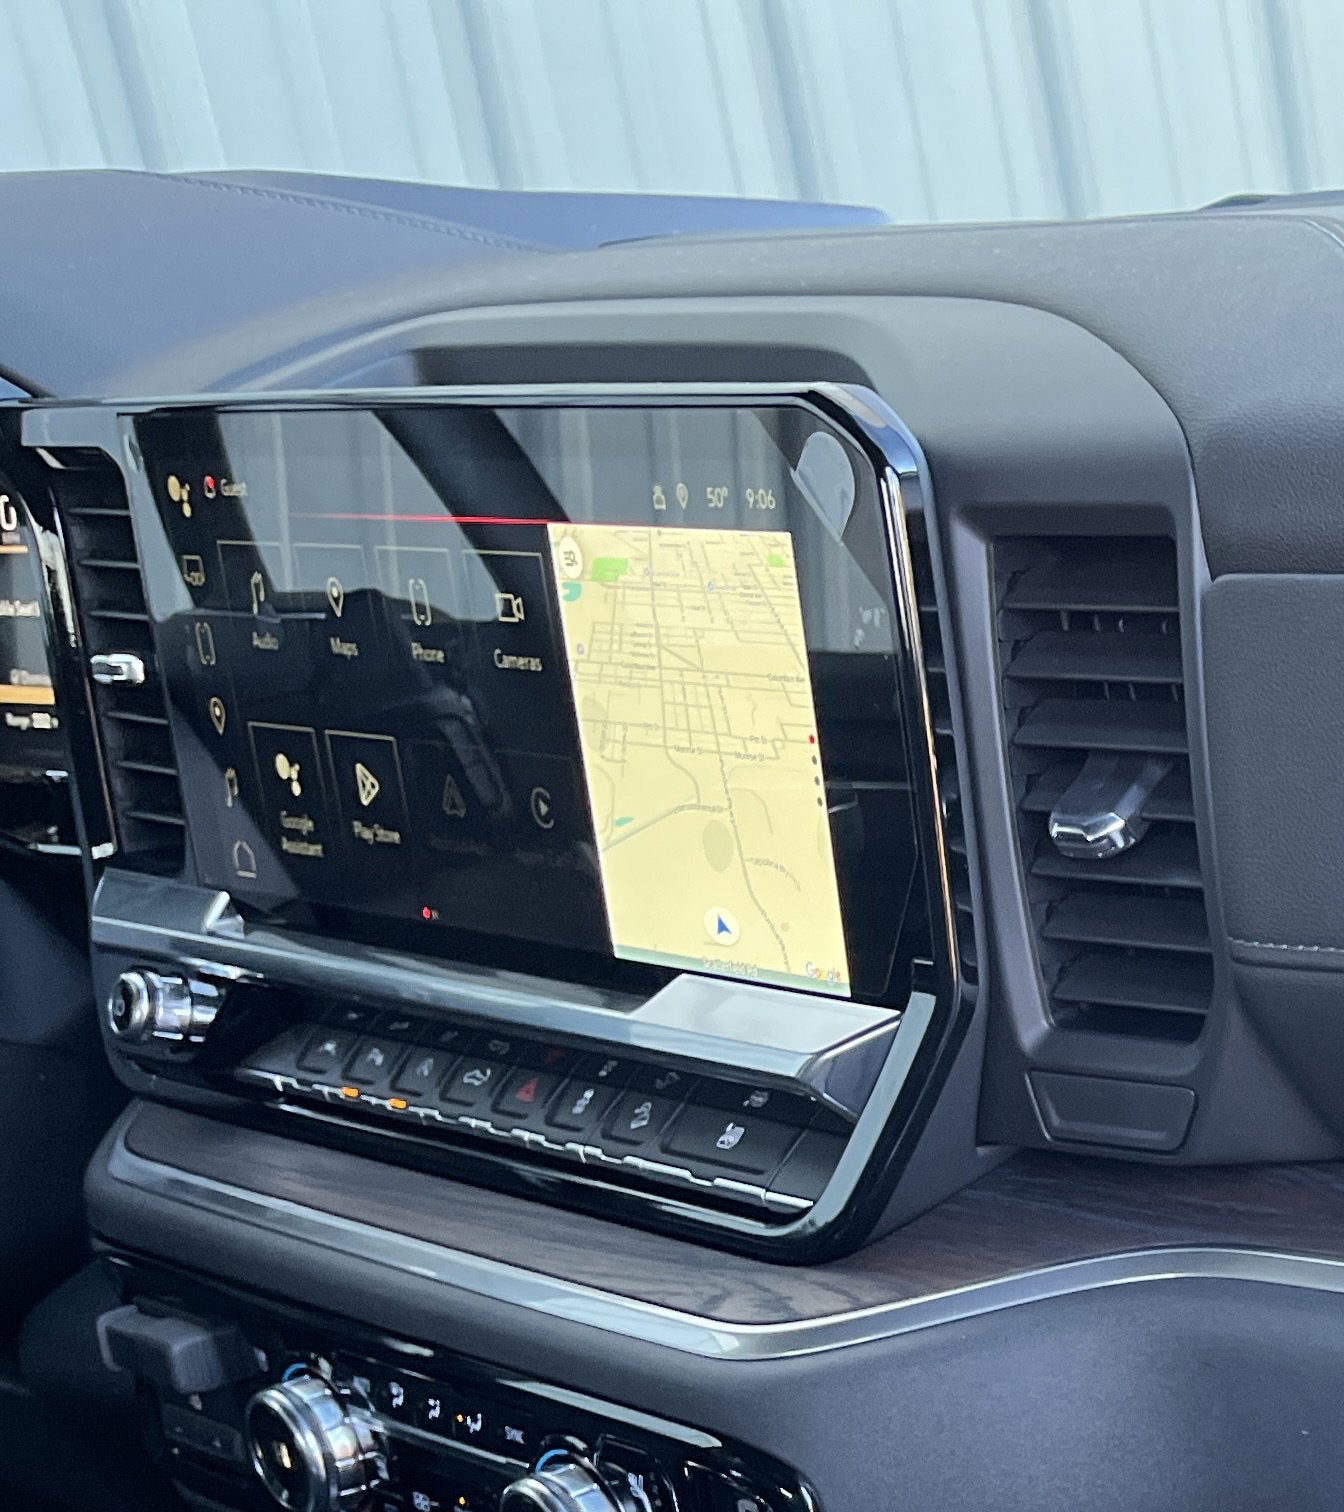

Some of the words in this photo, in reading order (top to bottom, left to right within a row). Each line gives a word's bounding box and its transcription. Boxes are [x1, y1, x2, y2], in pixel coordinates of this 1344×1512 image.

[745, 488, 776, 510] 9:06
[411, 642, 445, 663] Phone
[494, 648, 543, 671] Cameras
